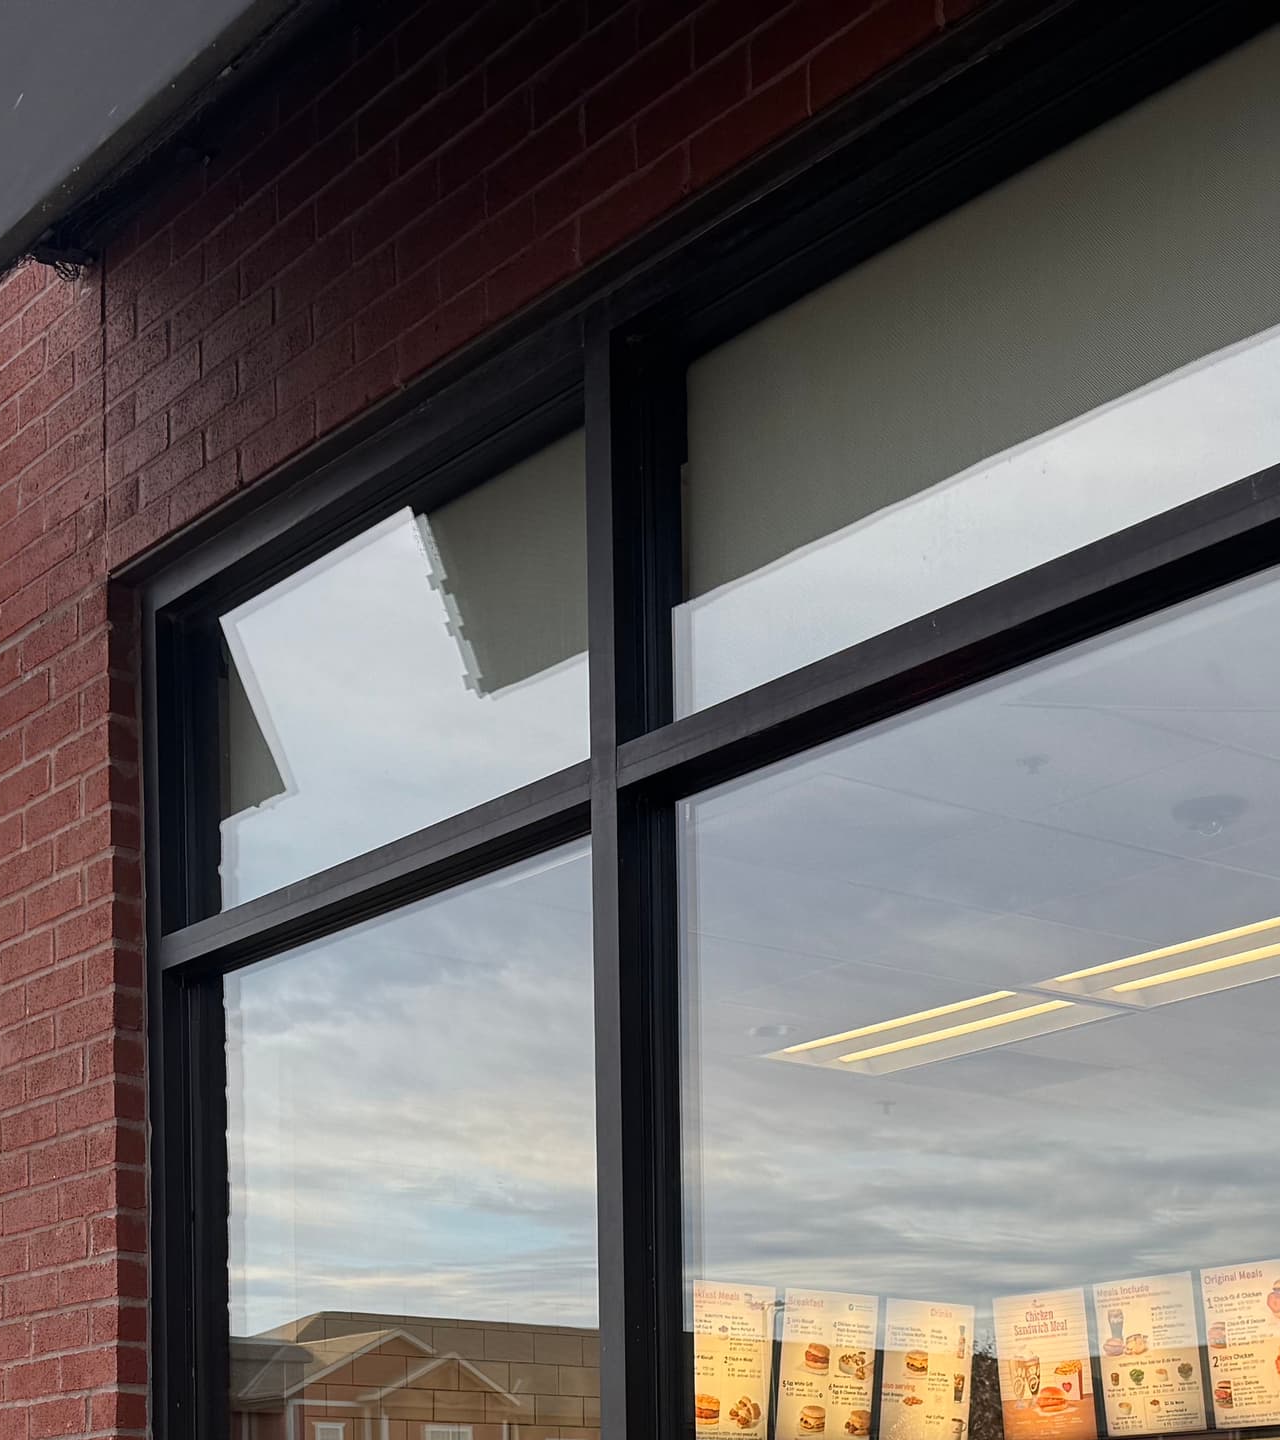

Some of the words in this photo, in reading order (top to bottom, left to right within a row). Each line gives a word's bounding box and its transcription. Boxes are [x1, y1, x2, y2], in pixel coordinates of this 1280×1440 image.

[1204, 1272, 1237, 1286] Original
[1239, 1269, 1263, 1280] Meals
[788, 1296, 824, 1308] Breakfast
[1207, 1297, 1213, 1309] 1
[1025, 1310, 1054, 1322] Chicken
[1014, 1322, 1049, 1337] Sandwich
[1050, 1319, 1068, 1332] Meal
[1212, 1356, 1219, 1368] 2
[1233, 1352, 1254, 1360] Chicken
